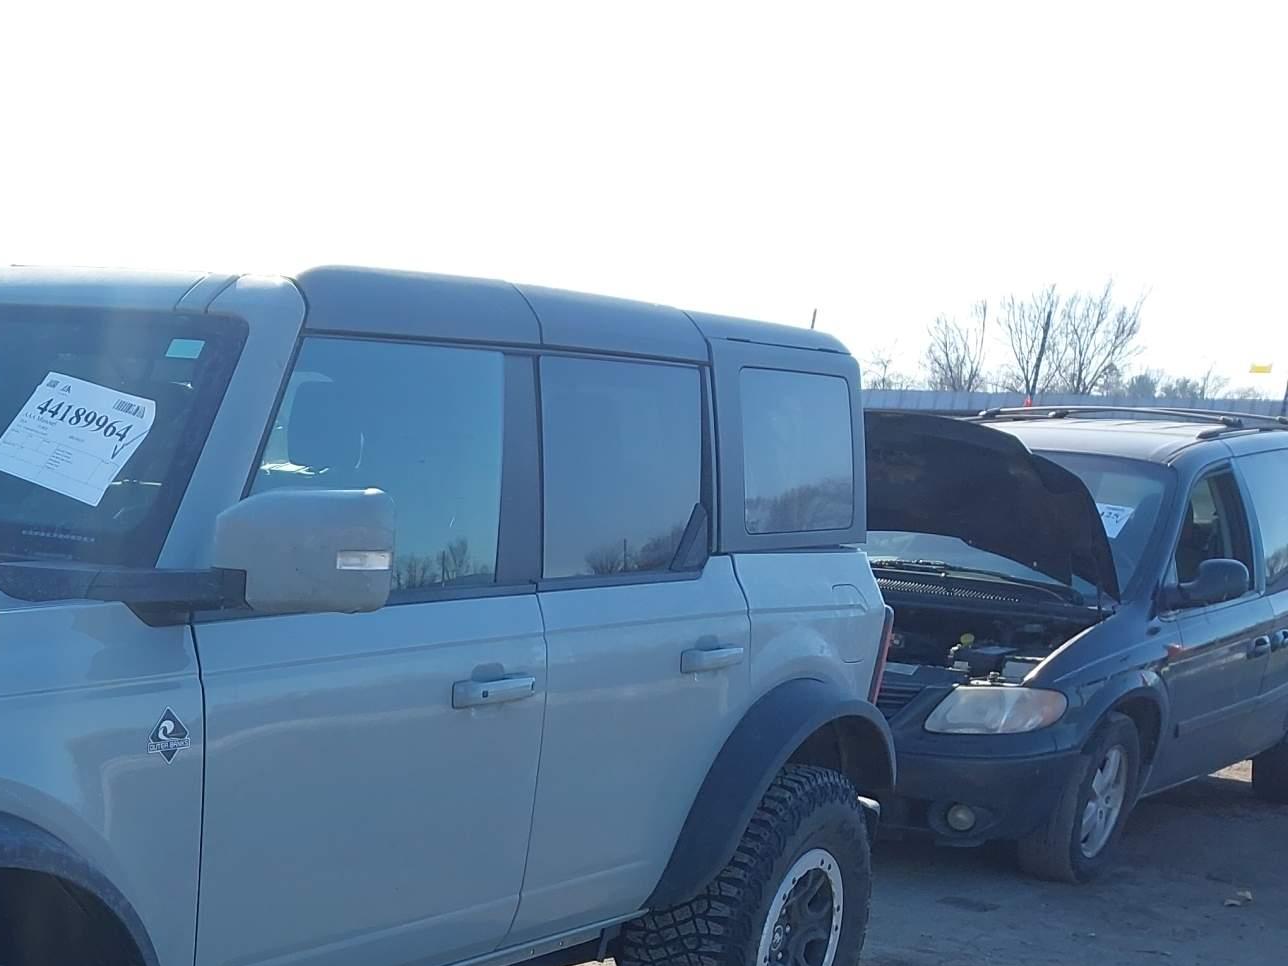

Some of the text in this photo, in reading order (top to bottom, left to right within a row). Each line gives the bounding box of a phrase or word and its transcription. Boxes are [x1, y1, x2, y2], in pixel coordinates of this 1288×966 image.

[36, 397, 134, 442] 44189964
[149, 739, 189, 751] OUTER BANKS
